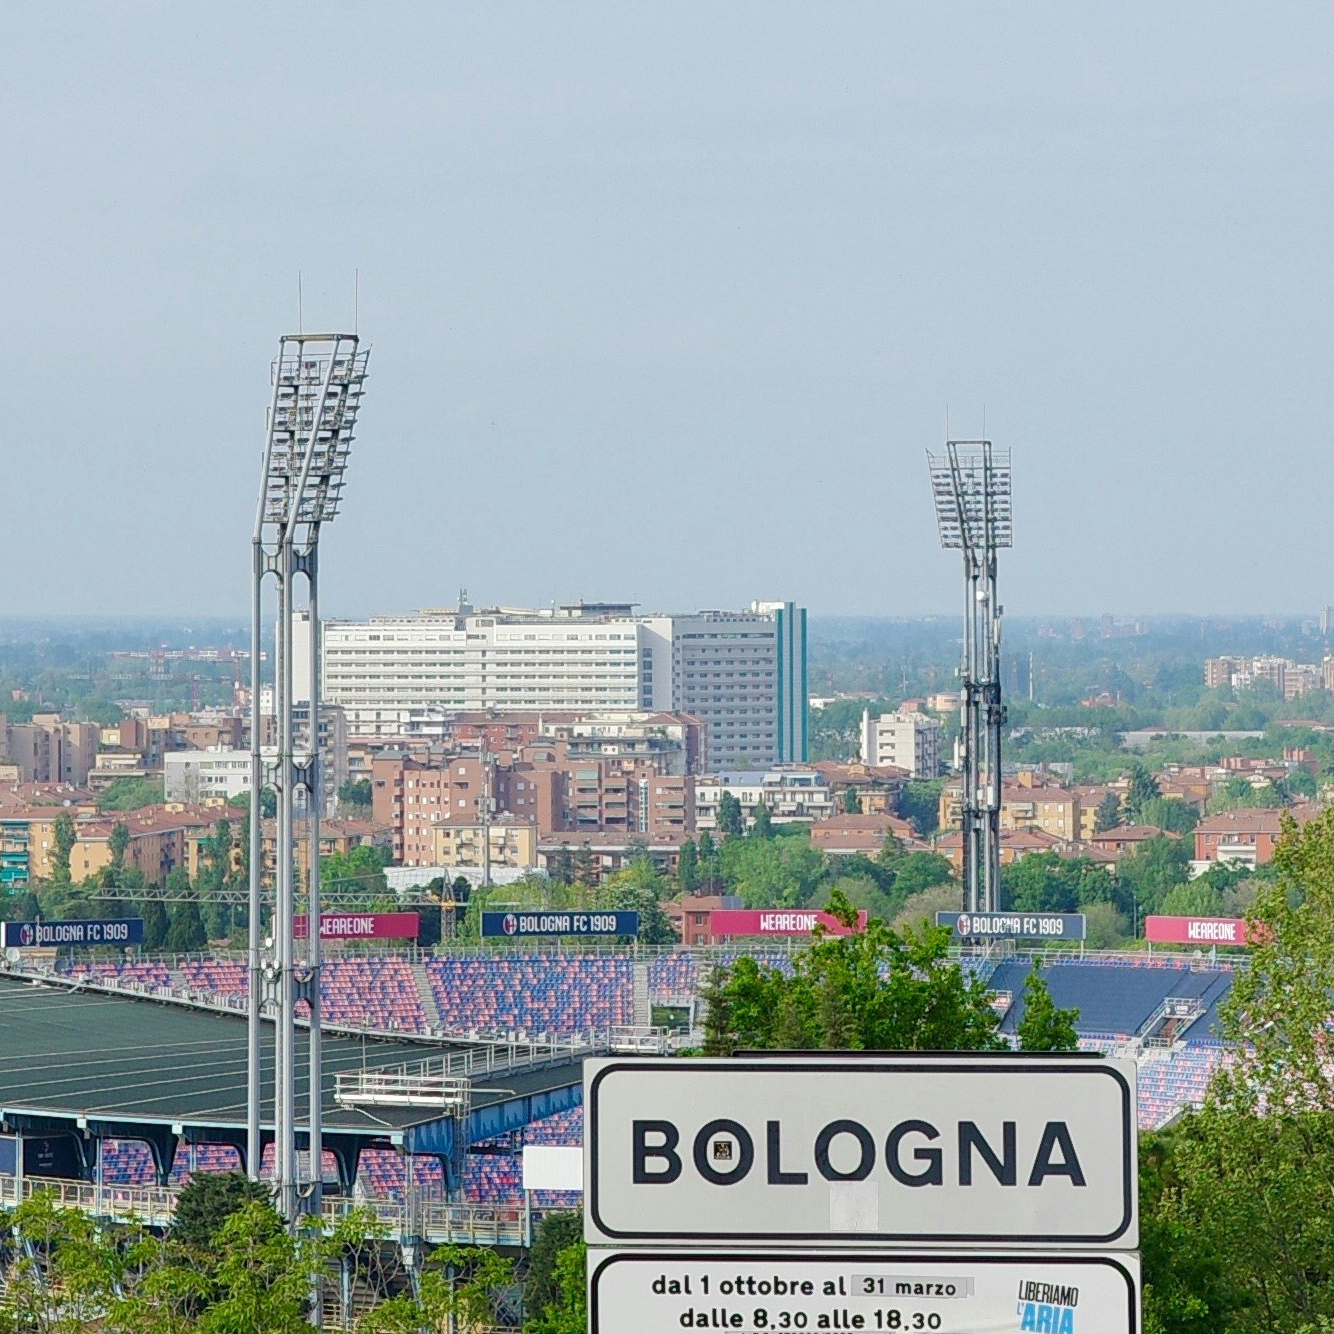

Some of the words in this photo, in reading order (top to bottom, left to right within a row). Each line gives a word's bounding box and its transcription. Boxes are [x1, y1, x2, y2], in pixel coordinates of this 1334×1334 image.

[36, 924, 84, 941] BOLOGNA
[87, 924, 101, 941] FC
[103, 923, 128, 940] 1909
[519, 915, 570, 933] BOLOGNA
[573, 915, 588, 932] FC
[589, 914, 616, 932] 1909
[760, 914, 818, 931] WEAREONE
[1023, 917, 1037, 934] FC
[1039, 918, 1064, 935] 1909
[1188, 921, 1236, 941] WEAREONE
[632, 1119, 1087, 1187] BOLOGNA
[651, 1275, 692, 1295] dal
[700, 1275, 710, 1295] 1
[719, 1276, 814, 1296] ottobre
[822, 1276, 847, 1296] al
[863, 1278, 885, 1294] 31
[895, 1282, 957, 1296] marzo
[1018, 1280, 1079, 1308] LIBERIAMO
[679, 1308, 744, 1329] dalle
[817, 1310, 865, 1329] alle
